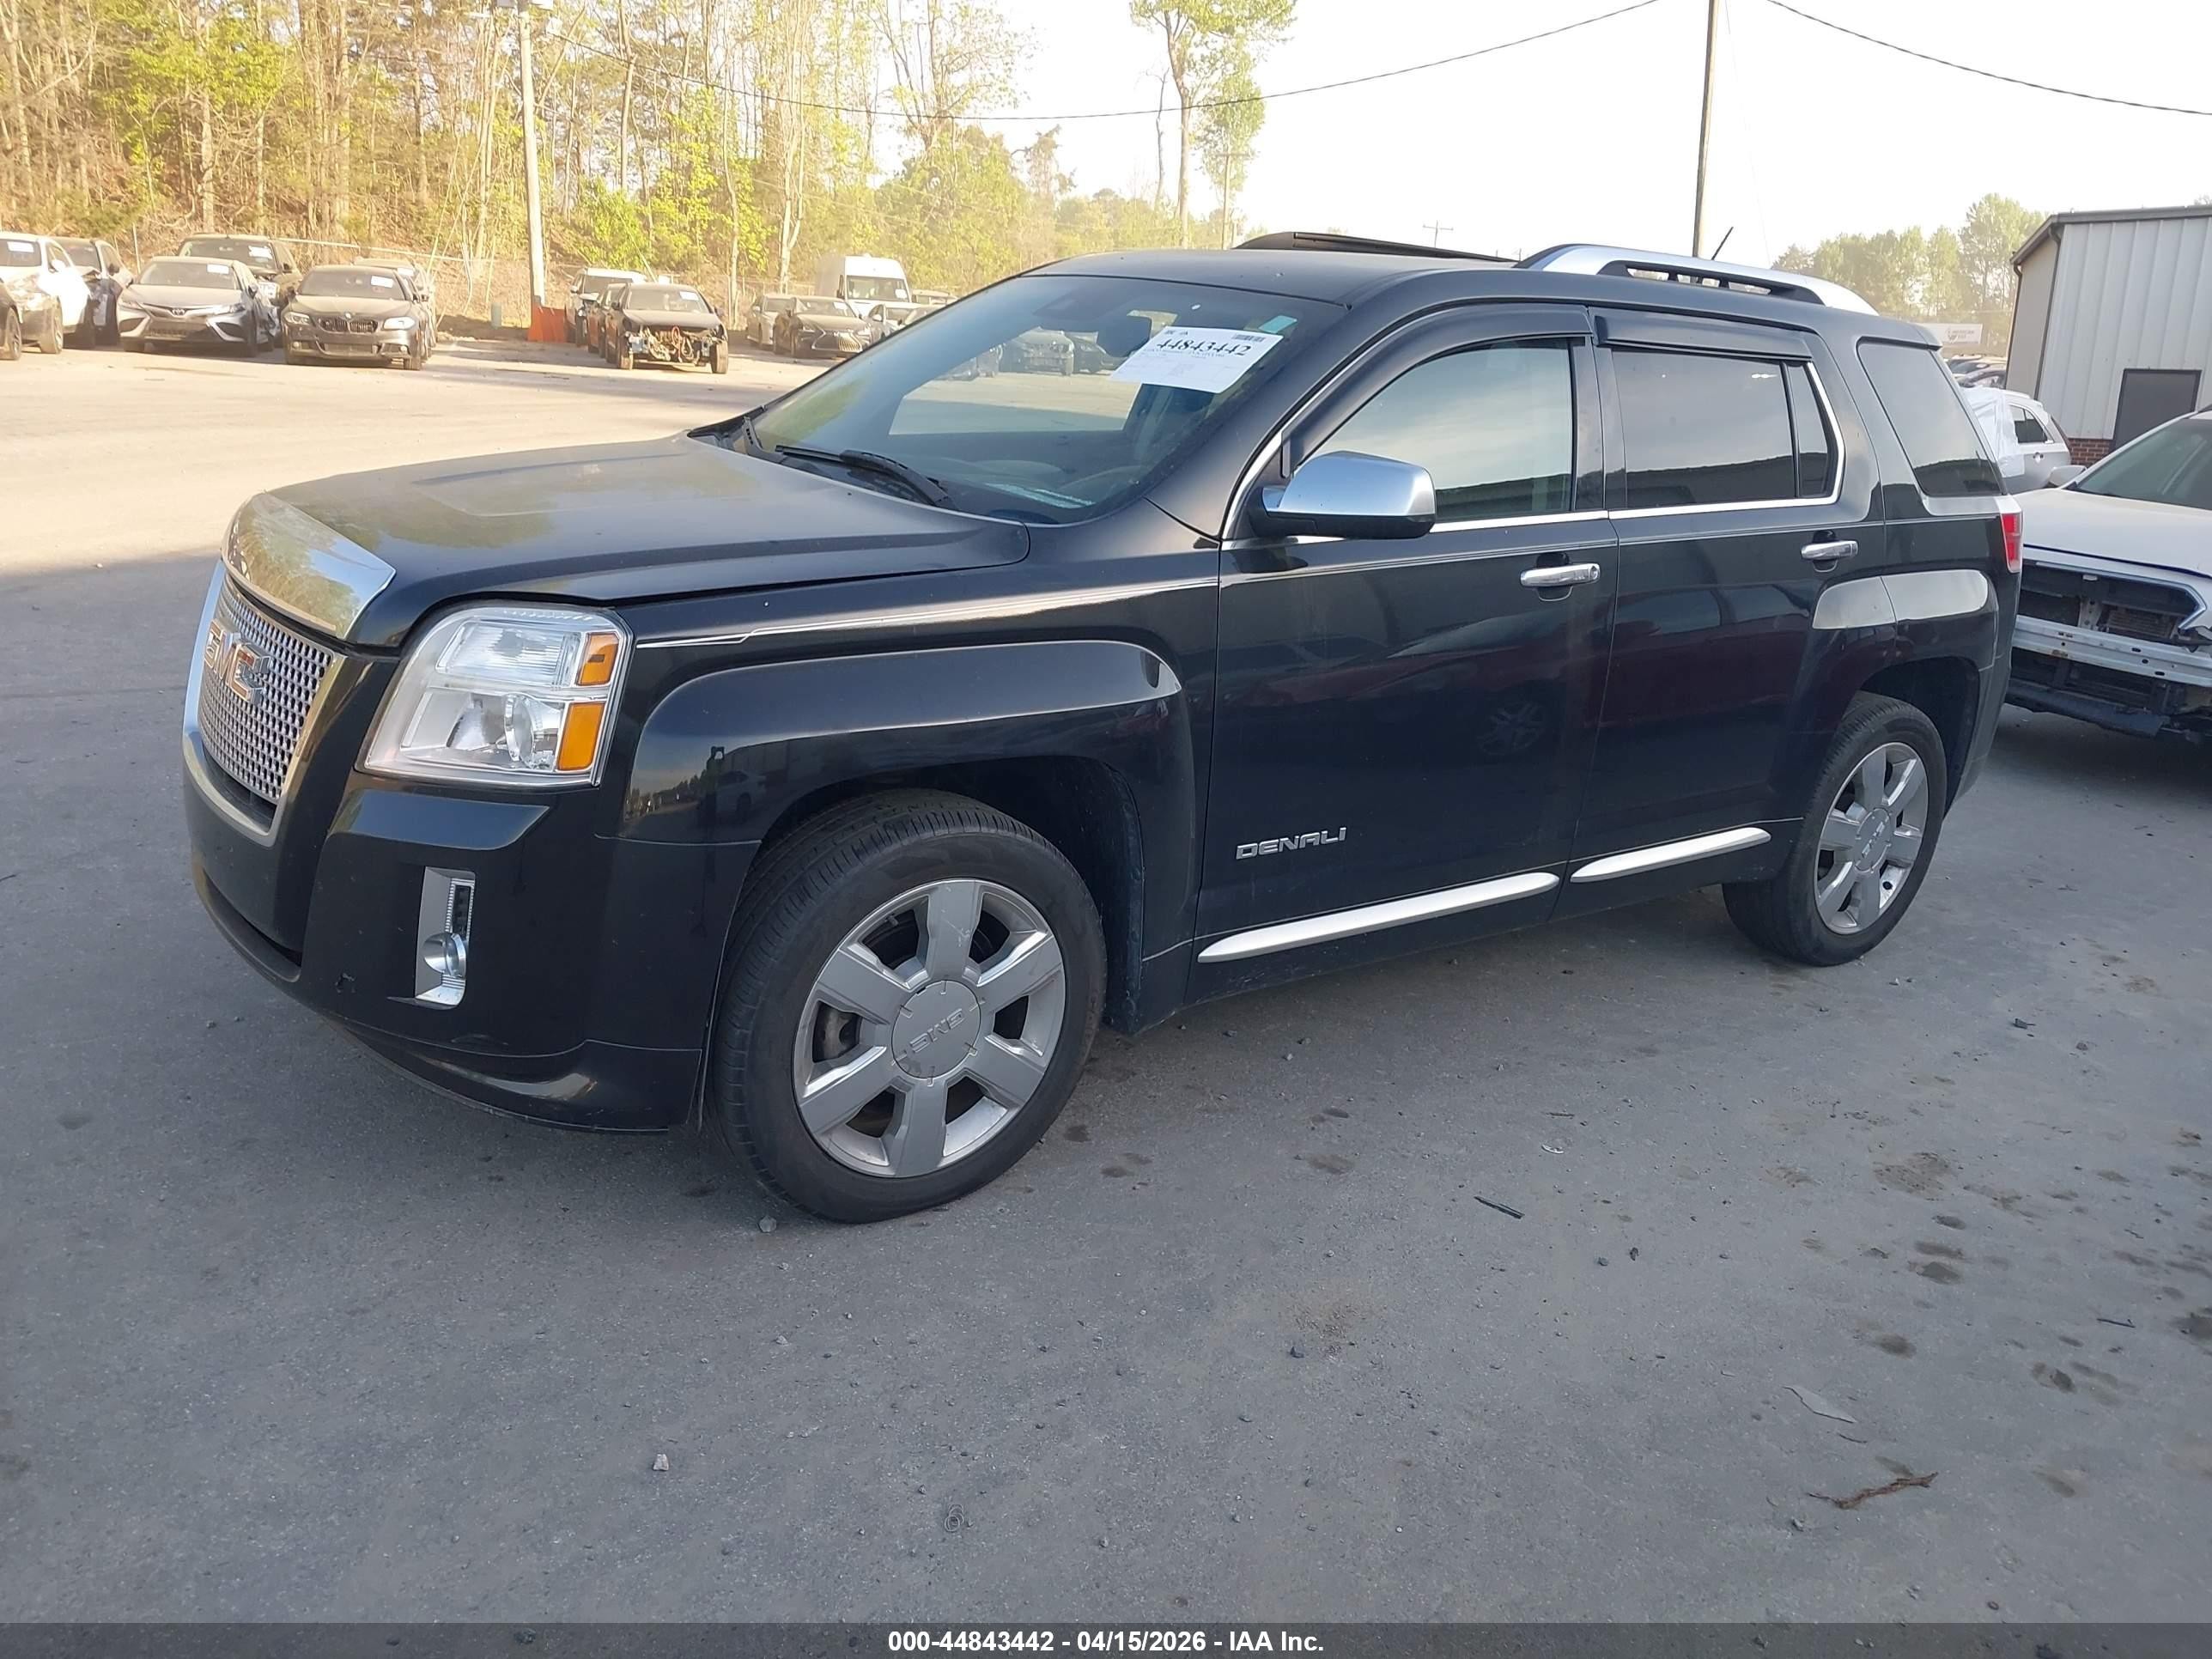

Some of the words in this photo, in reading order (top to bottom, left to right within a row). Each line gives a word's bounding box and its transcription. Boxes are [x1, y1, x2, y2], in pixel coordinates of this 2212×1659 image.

[1157, 338, 1251, 356] 44843442
[204, 620, 263, 704] GMC
[1236, 827, 1346, 860] DENALI
[909, 1008, 963, 1053] GMC
